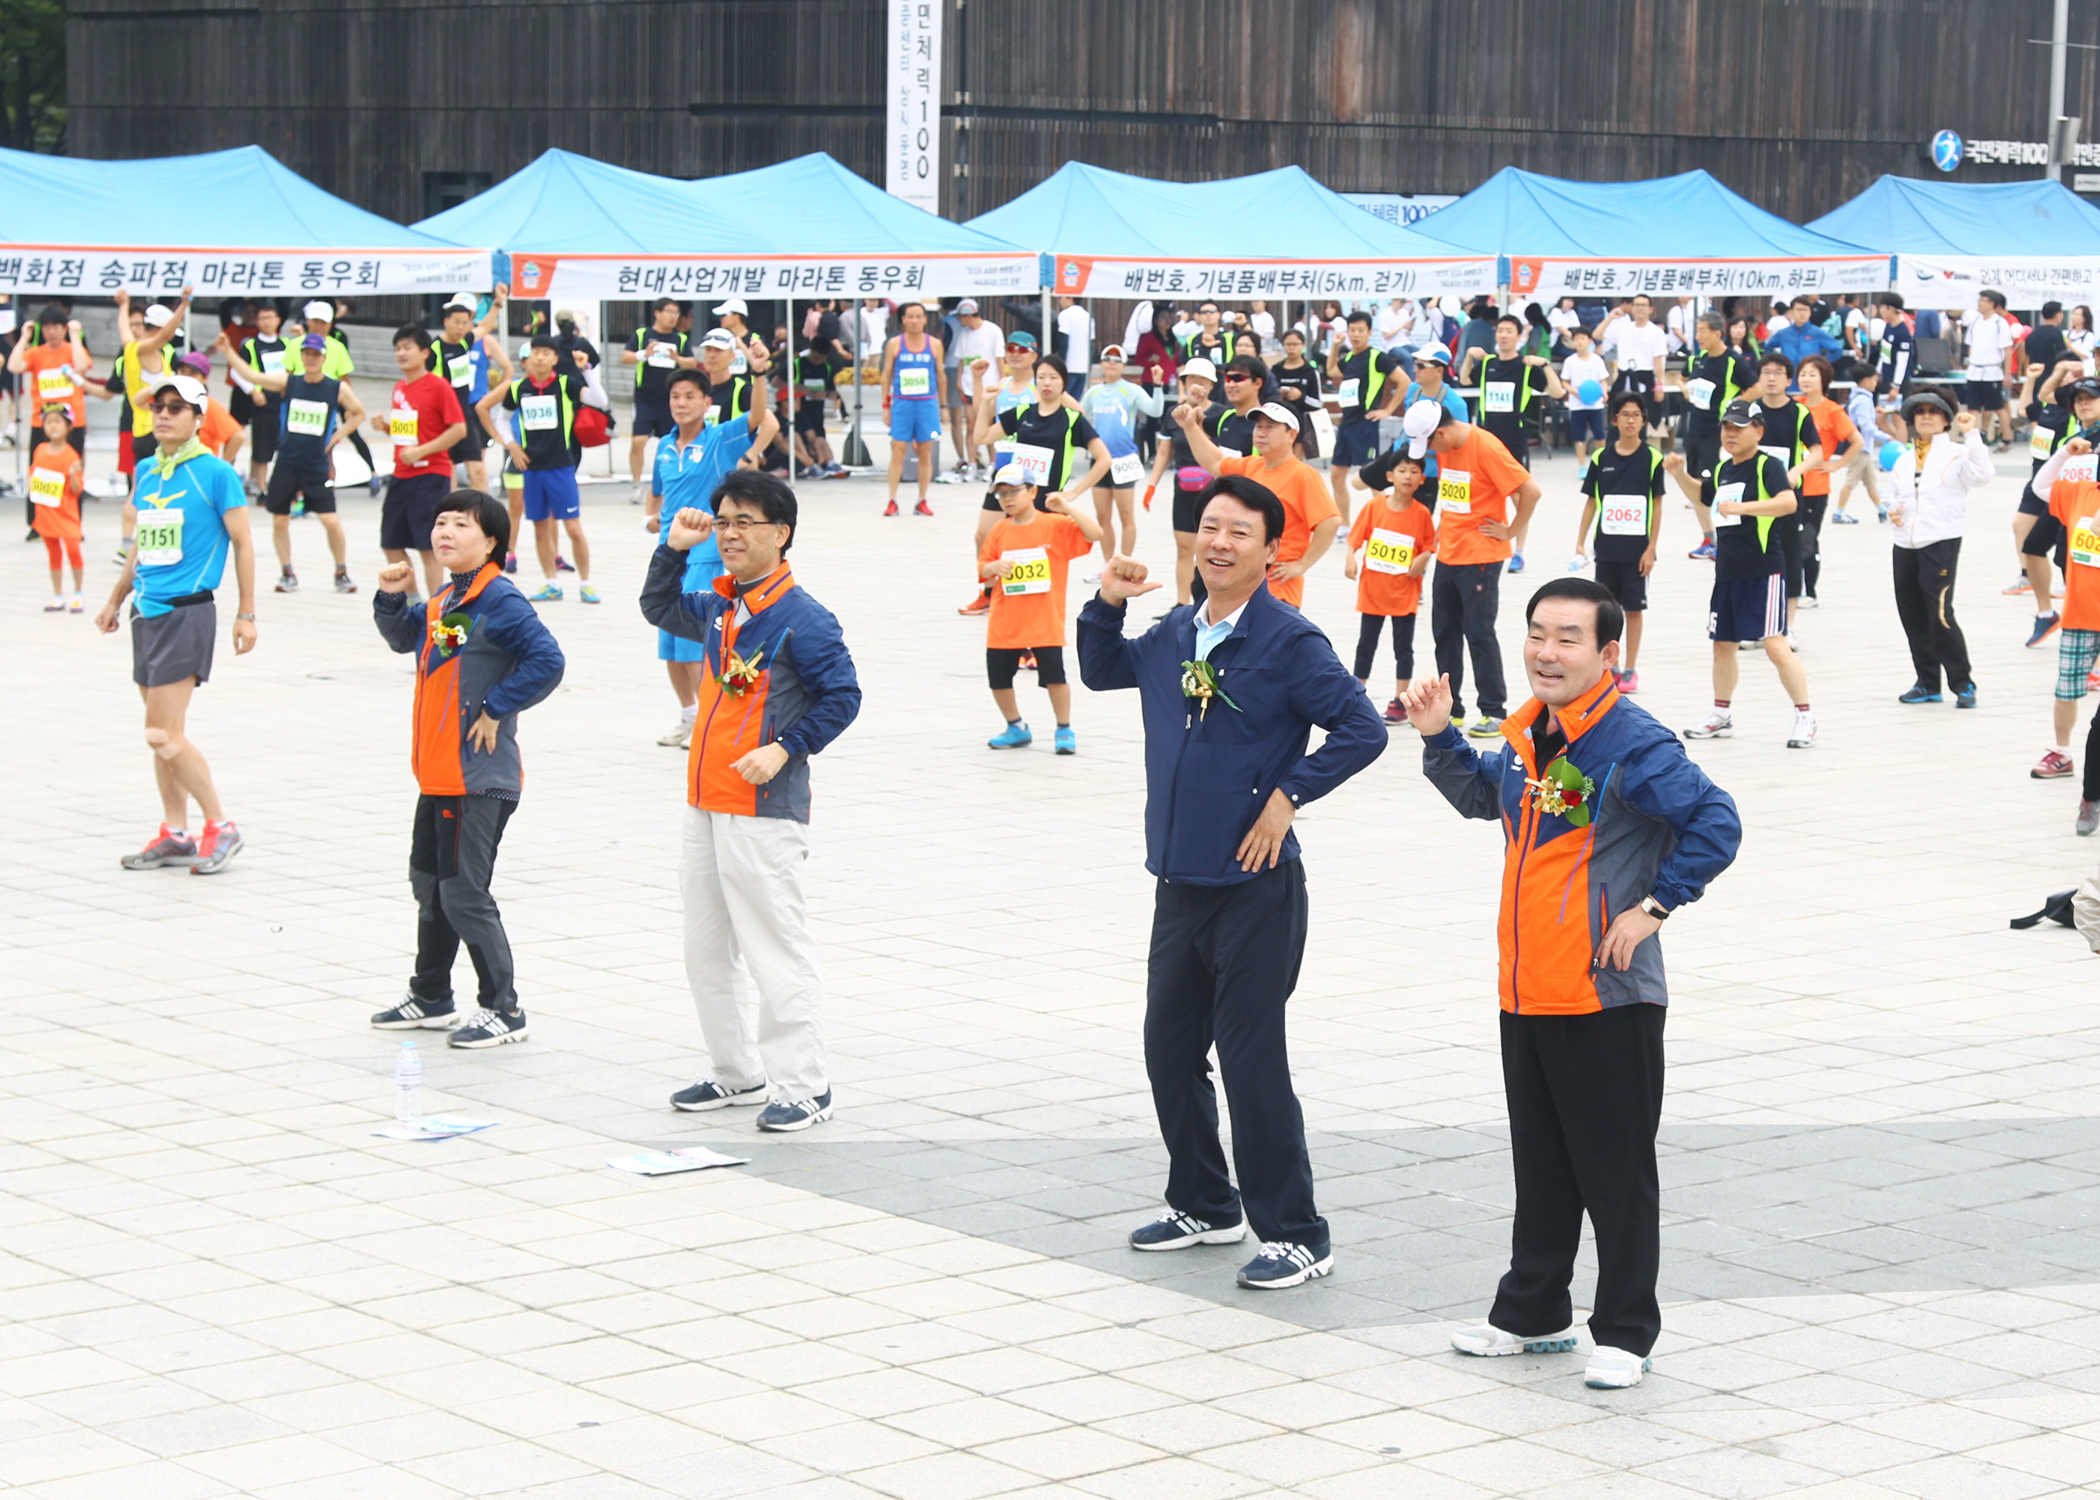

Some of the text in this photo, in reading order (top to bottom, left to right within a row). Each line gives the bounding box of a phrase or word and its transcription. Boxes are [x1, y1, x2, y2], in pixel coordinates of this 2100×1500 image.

[0, 258, 380, 290] 백화점 송파점 마라톤 동우회
[618, 265, 925, 293] 현대산업개발 마라톤 동우회
[1489, 392, 1510, 402] 1141
[291, 410, 321, 425] 3131
[525, 407, 553, 419] 1036
[392, 421, 414, 434] 5003
[1114, 460, 1140, 474] 9005
[2062, 467, 2093, 481] 2082
[1442, 483, 1466, 500] 5020
[1606, 508, 1642, 523] 2062
[140, 528, 176, 548] 3151
[1370, 542, 1408, 563] 5019
